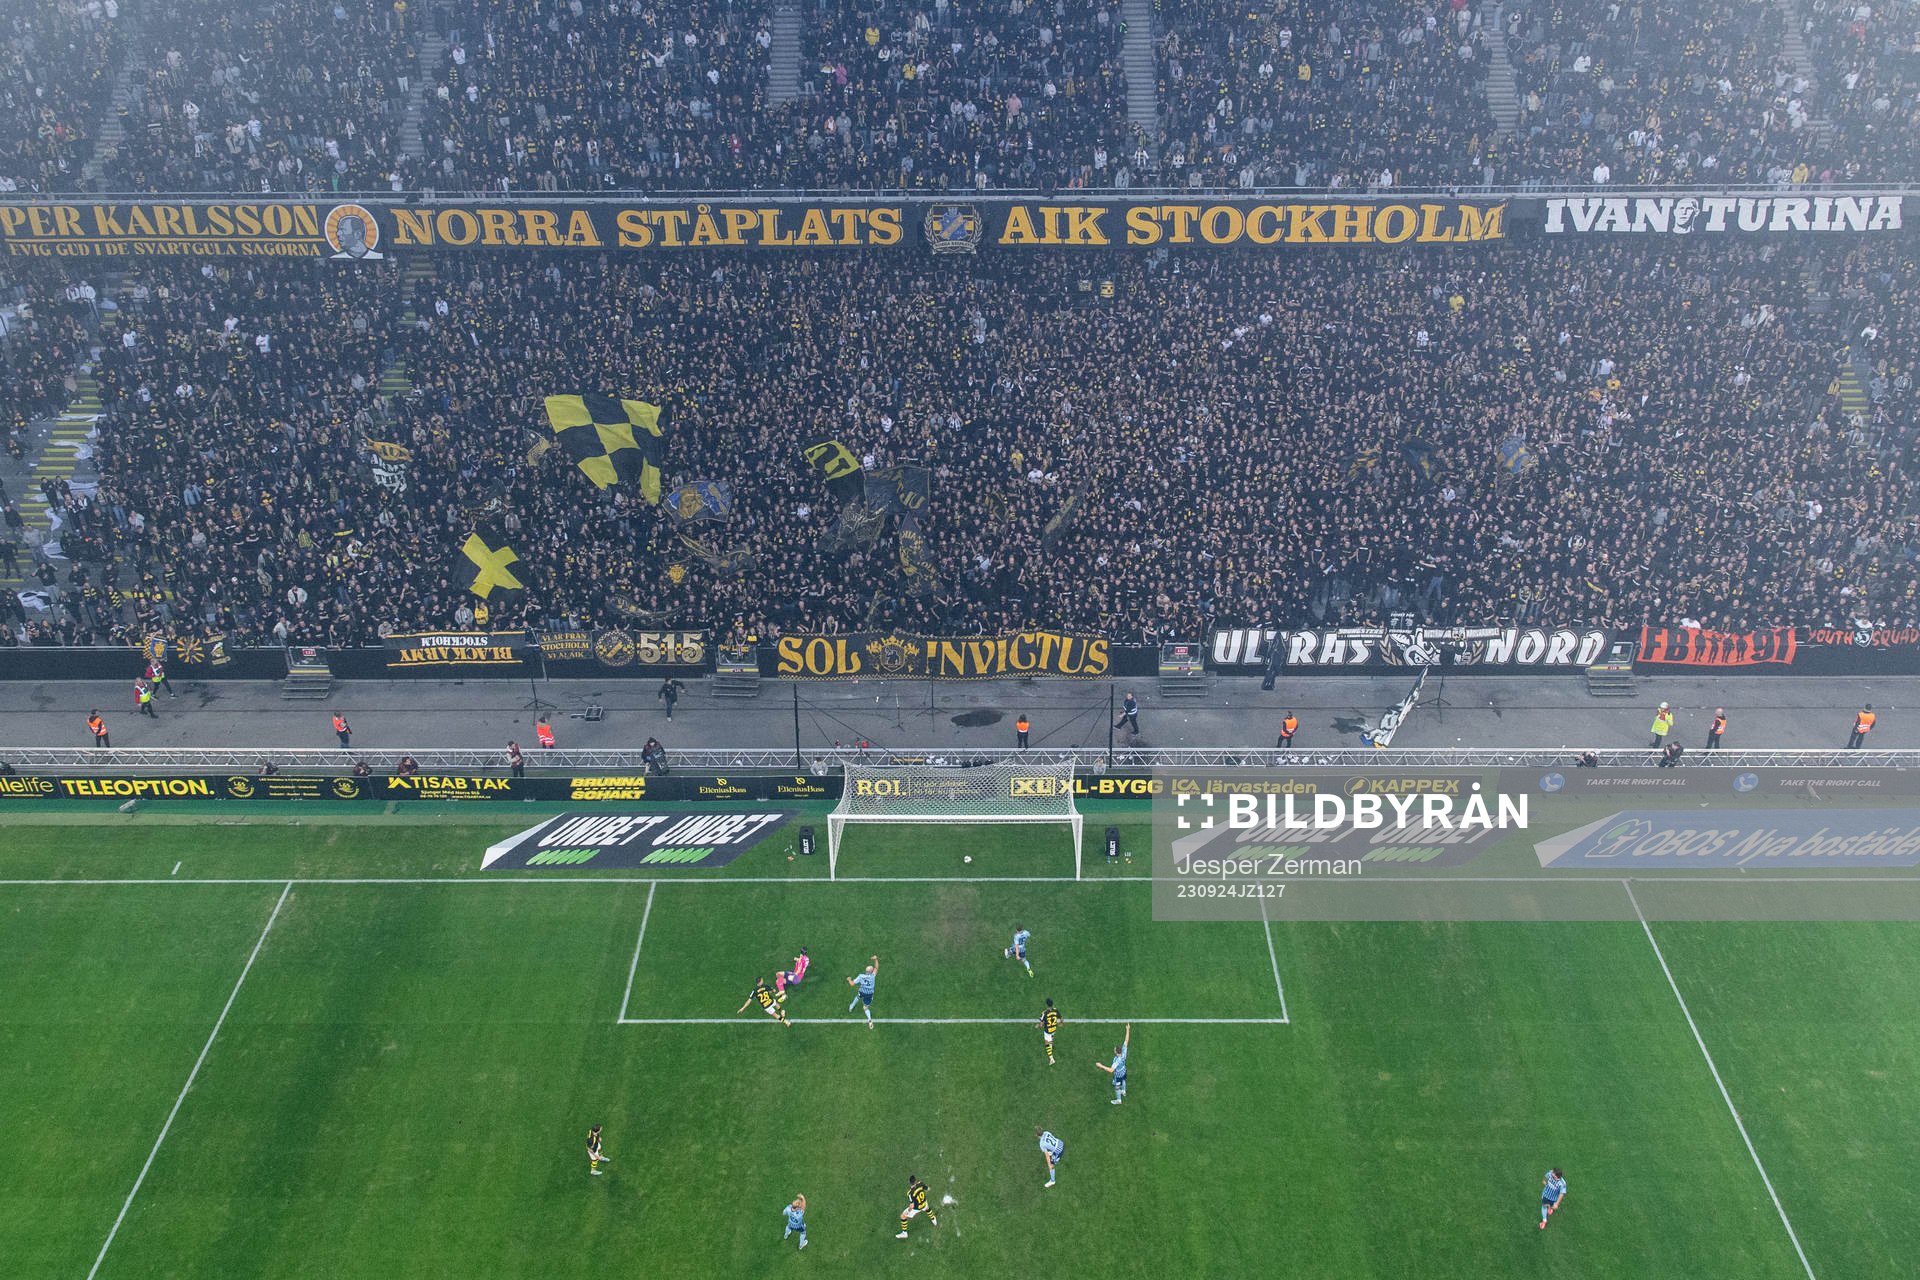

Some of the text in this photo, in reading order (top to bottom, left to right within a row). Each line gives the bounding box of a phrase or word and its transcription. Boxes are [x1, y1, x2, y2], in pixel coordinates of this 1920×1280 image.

[0, 205, 319, 236] PER KARLSSON
[1545, 196, 1902, 233] IVAN TURINA
[390, 204, 903, 247] NORRA STÅPLATS
[998, 202, 1508, 245] AIK STOCKHOLM
[56, 243, 90, 256] GUD
[105, 243, 130, 255] DE
[136, 242, 233, 256] SVARTGULA
[242, 242, 321, 256] SAGORNA
[421, 636, 488, 647] STOCKHOLM
[639, 633, 705, 664] 515
[1484, 628, 1606, 665] NORD
[400, 647, 513, 663] BLACK ARMY
[778, 637, 862, 675] SOL
[0, 777, 54, 793] lelife
[61, 779, 215, 796] TELEOPTION.
[410, 777, 511, 790] TISAB TAK
[570, 777, 646, 787] BRUNNA
[1059, 779, 1164, 795] XL-BYGG
[1172, 779, 1201, 791] ICA
[1206, 779, 1317, 794] Järvastaden
[1370, 779, 1461, 793] KAPPEX
[1586, 778, 1687, 786] TAKE THE RIGHT CALL
[1780, 779, 1881, 787] TAKE THE RIGHT CALL
[570, 790, 646, 800] SCHAKT
[537, 816, 669, 847] UNIBET
[651, 814, 783, 845] UNIBET
[1632, 829, 1740, 857] OBOS
[1722, 829, 1798, 865] Nya
[757, 991, 770, 1003] 28
[1047, 1016, 1057, 1026] 32
[916, 1191, 925, 1204] 19
